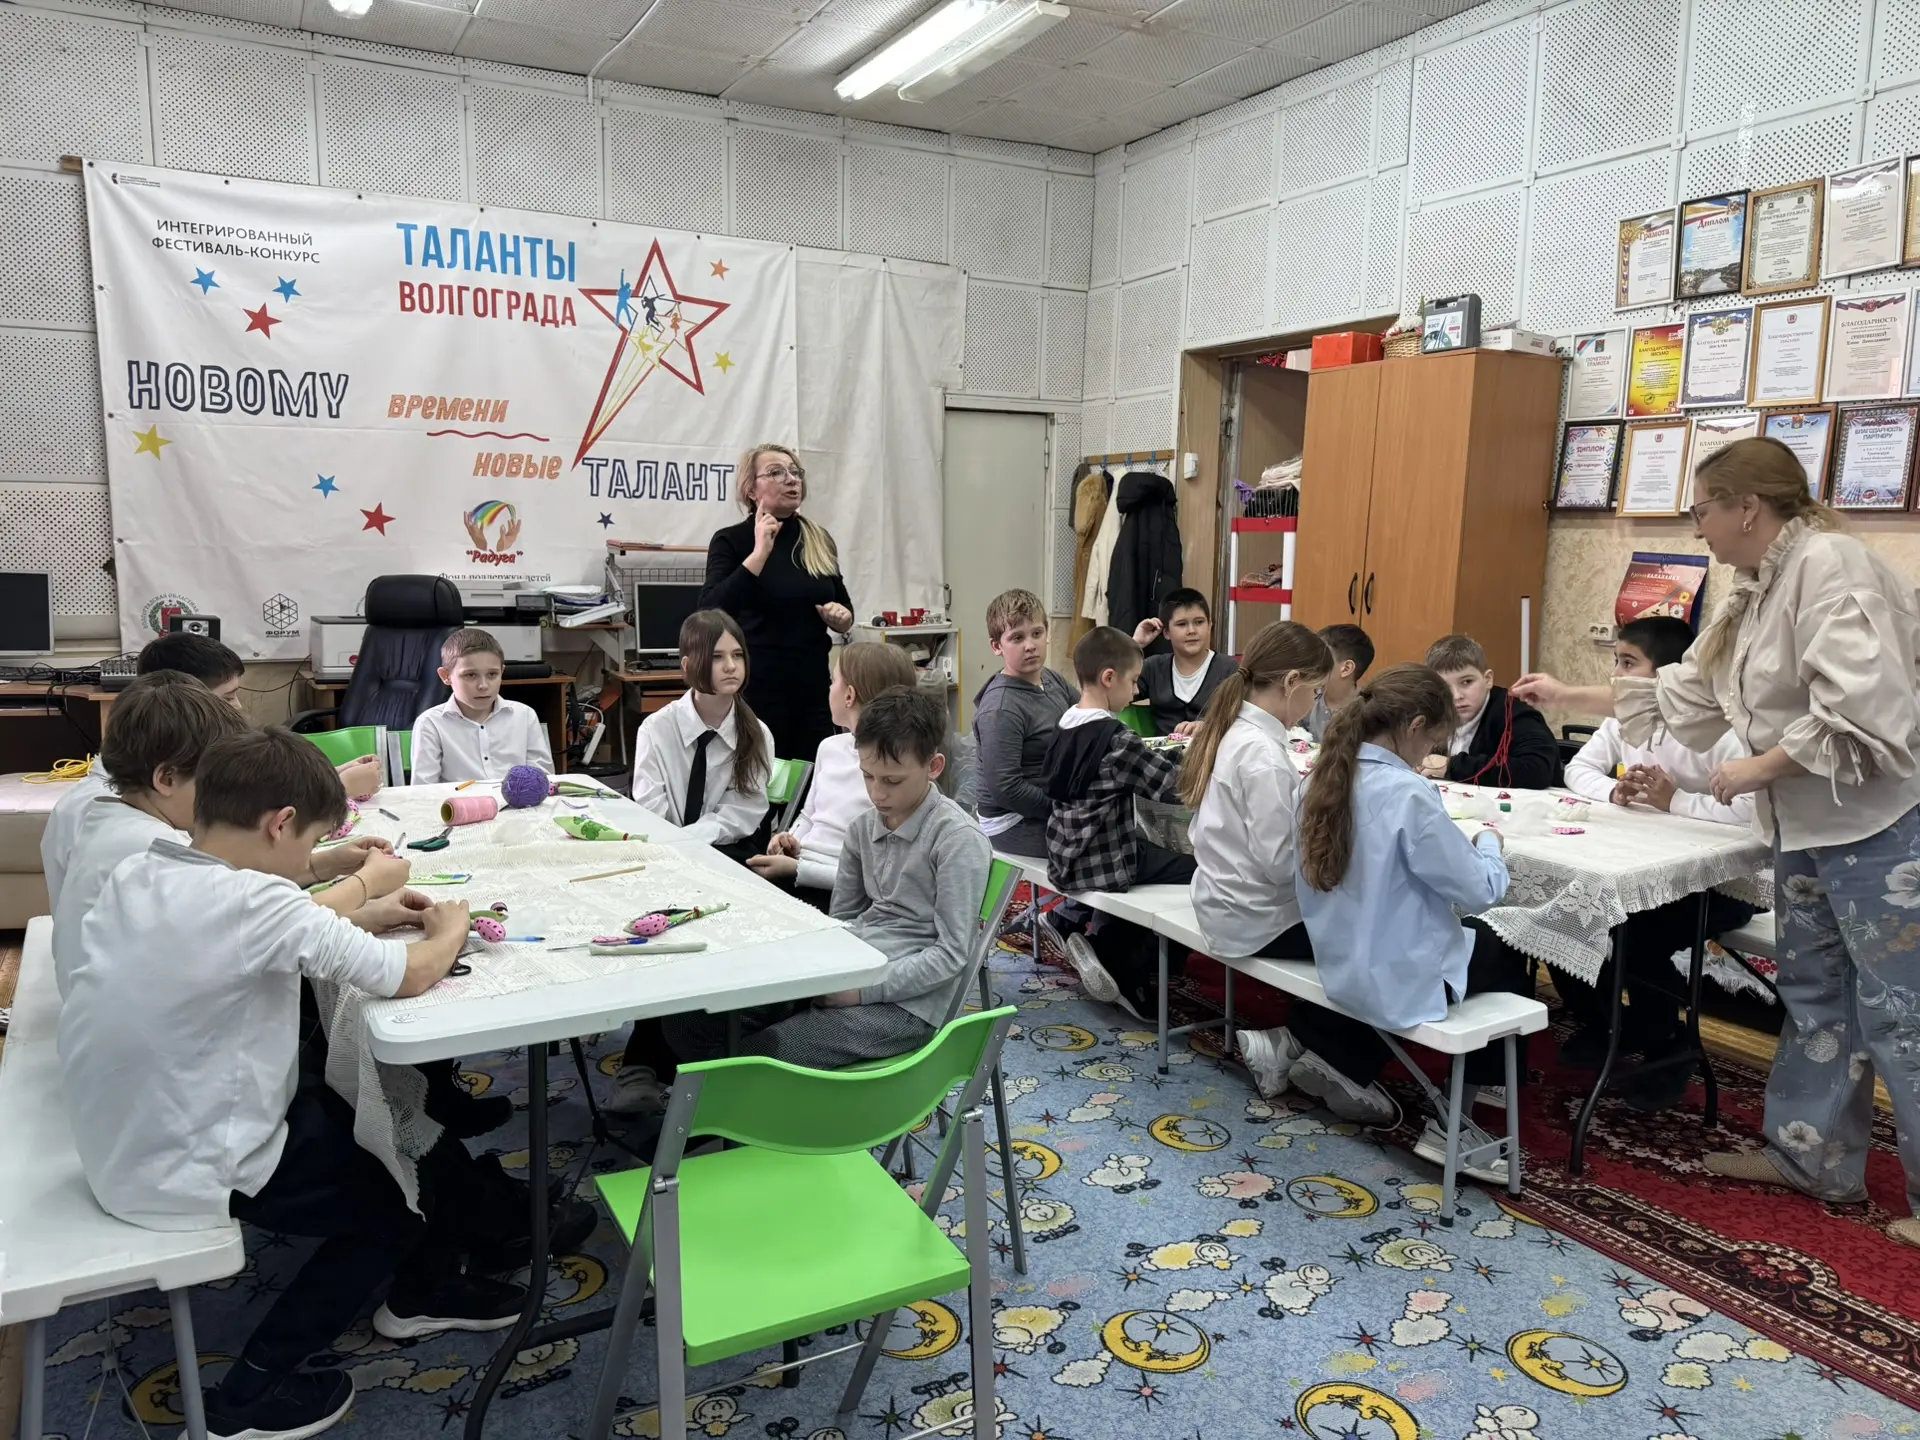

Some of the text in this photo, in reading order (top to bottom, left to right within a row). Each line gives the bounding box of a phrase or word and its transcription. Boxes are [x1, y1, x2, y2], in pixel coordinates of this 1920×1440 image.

[152, 236, 320, 263] ФЕСТИВАЛЬ-КОНКУРС
[156, 219, 313, 246] ИНТЕГРИРОВАННЫЙ
[396, 222, 576, 282] ТАЛАНТЫ
[399, 281, 577, 328] ВОЛГОГРАДА
[127, 360, 349, 419] НОВОМУ
[1576, 445, 1605, 453] ДИПЛОМ
[582, 457, 737, 502] ТАЛАНТ
